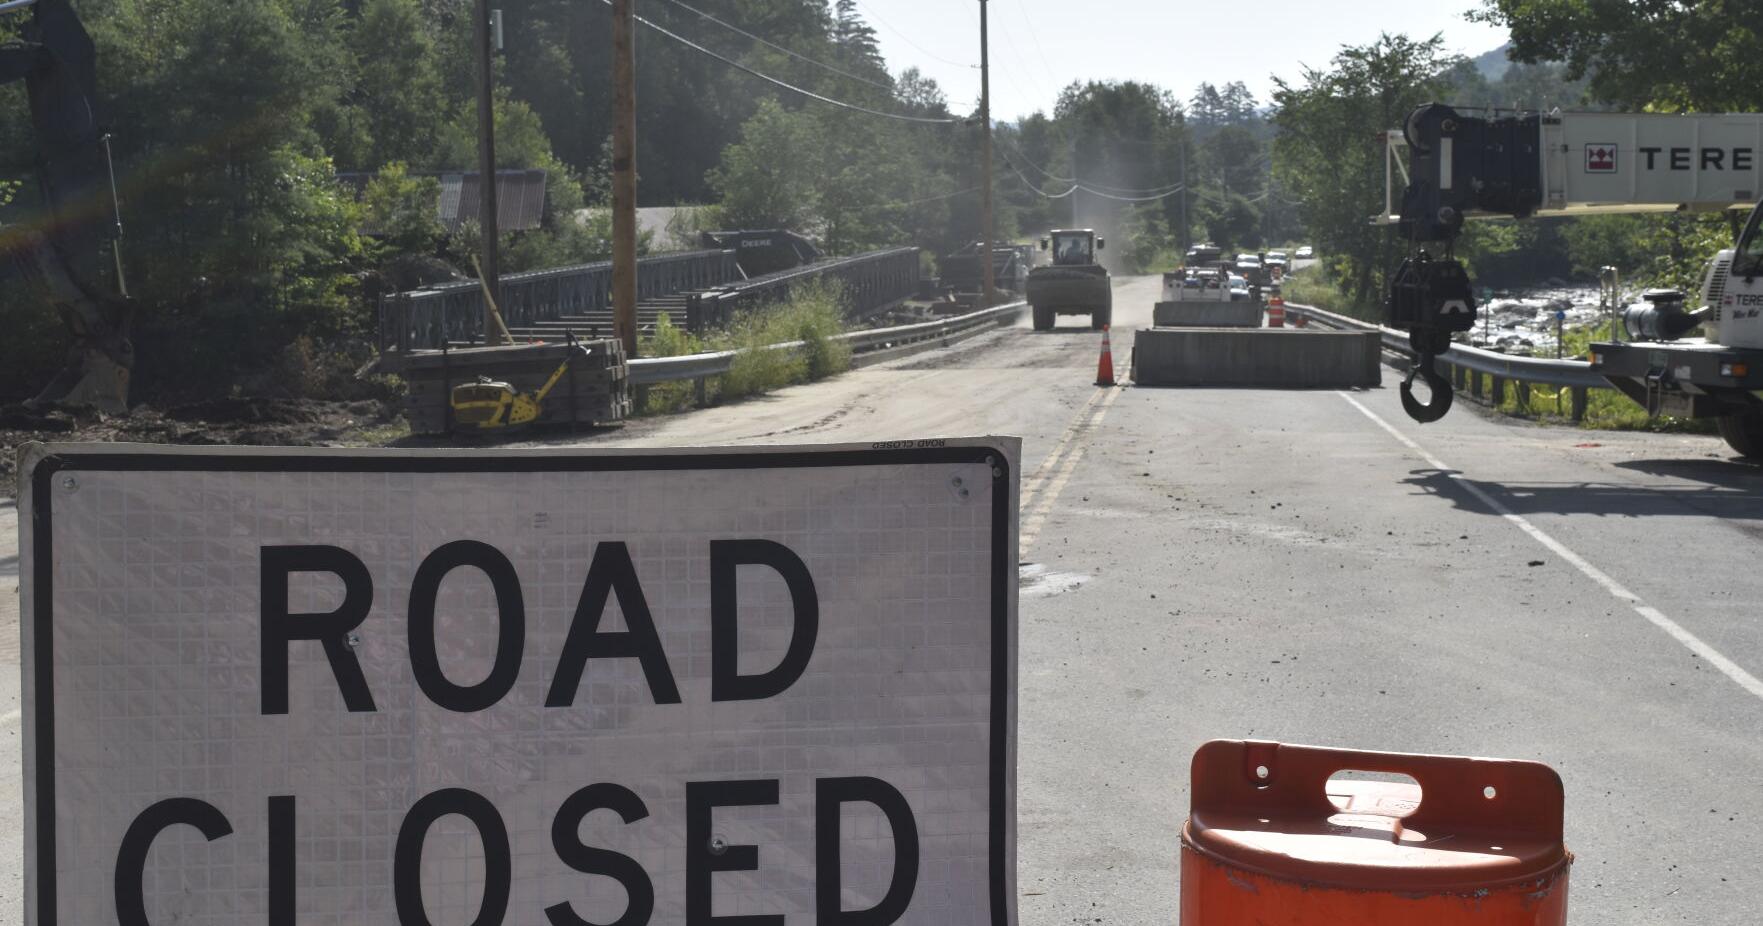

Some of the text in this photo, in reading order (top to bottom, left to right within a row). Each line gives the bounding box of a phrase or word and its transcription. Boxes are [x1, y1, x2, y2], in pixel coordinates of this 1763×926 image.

[1639, 147, 1752, 170] TERE
[741, 240, 772, 248] DEERE
[872, 439, 945, 449] ROAD CLOSED
[260, 539, 819, 715] ROAD
[114, 776, 920, 926] CLOSED
